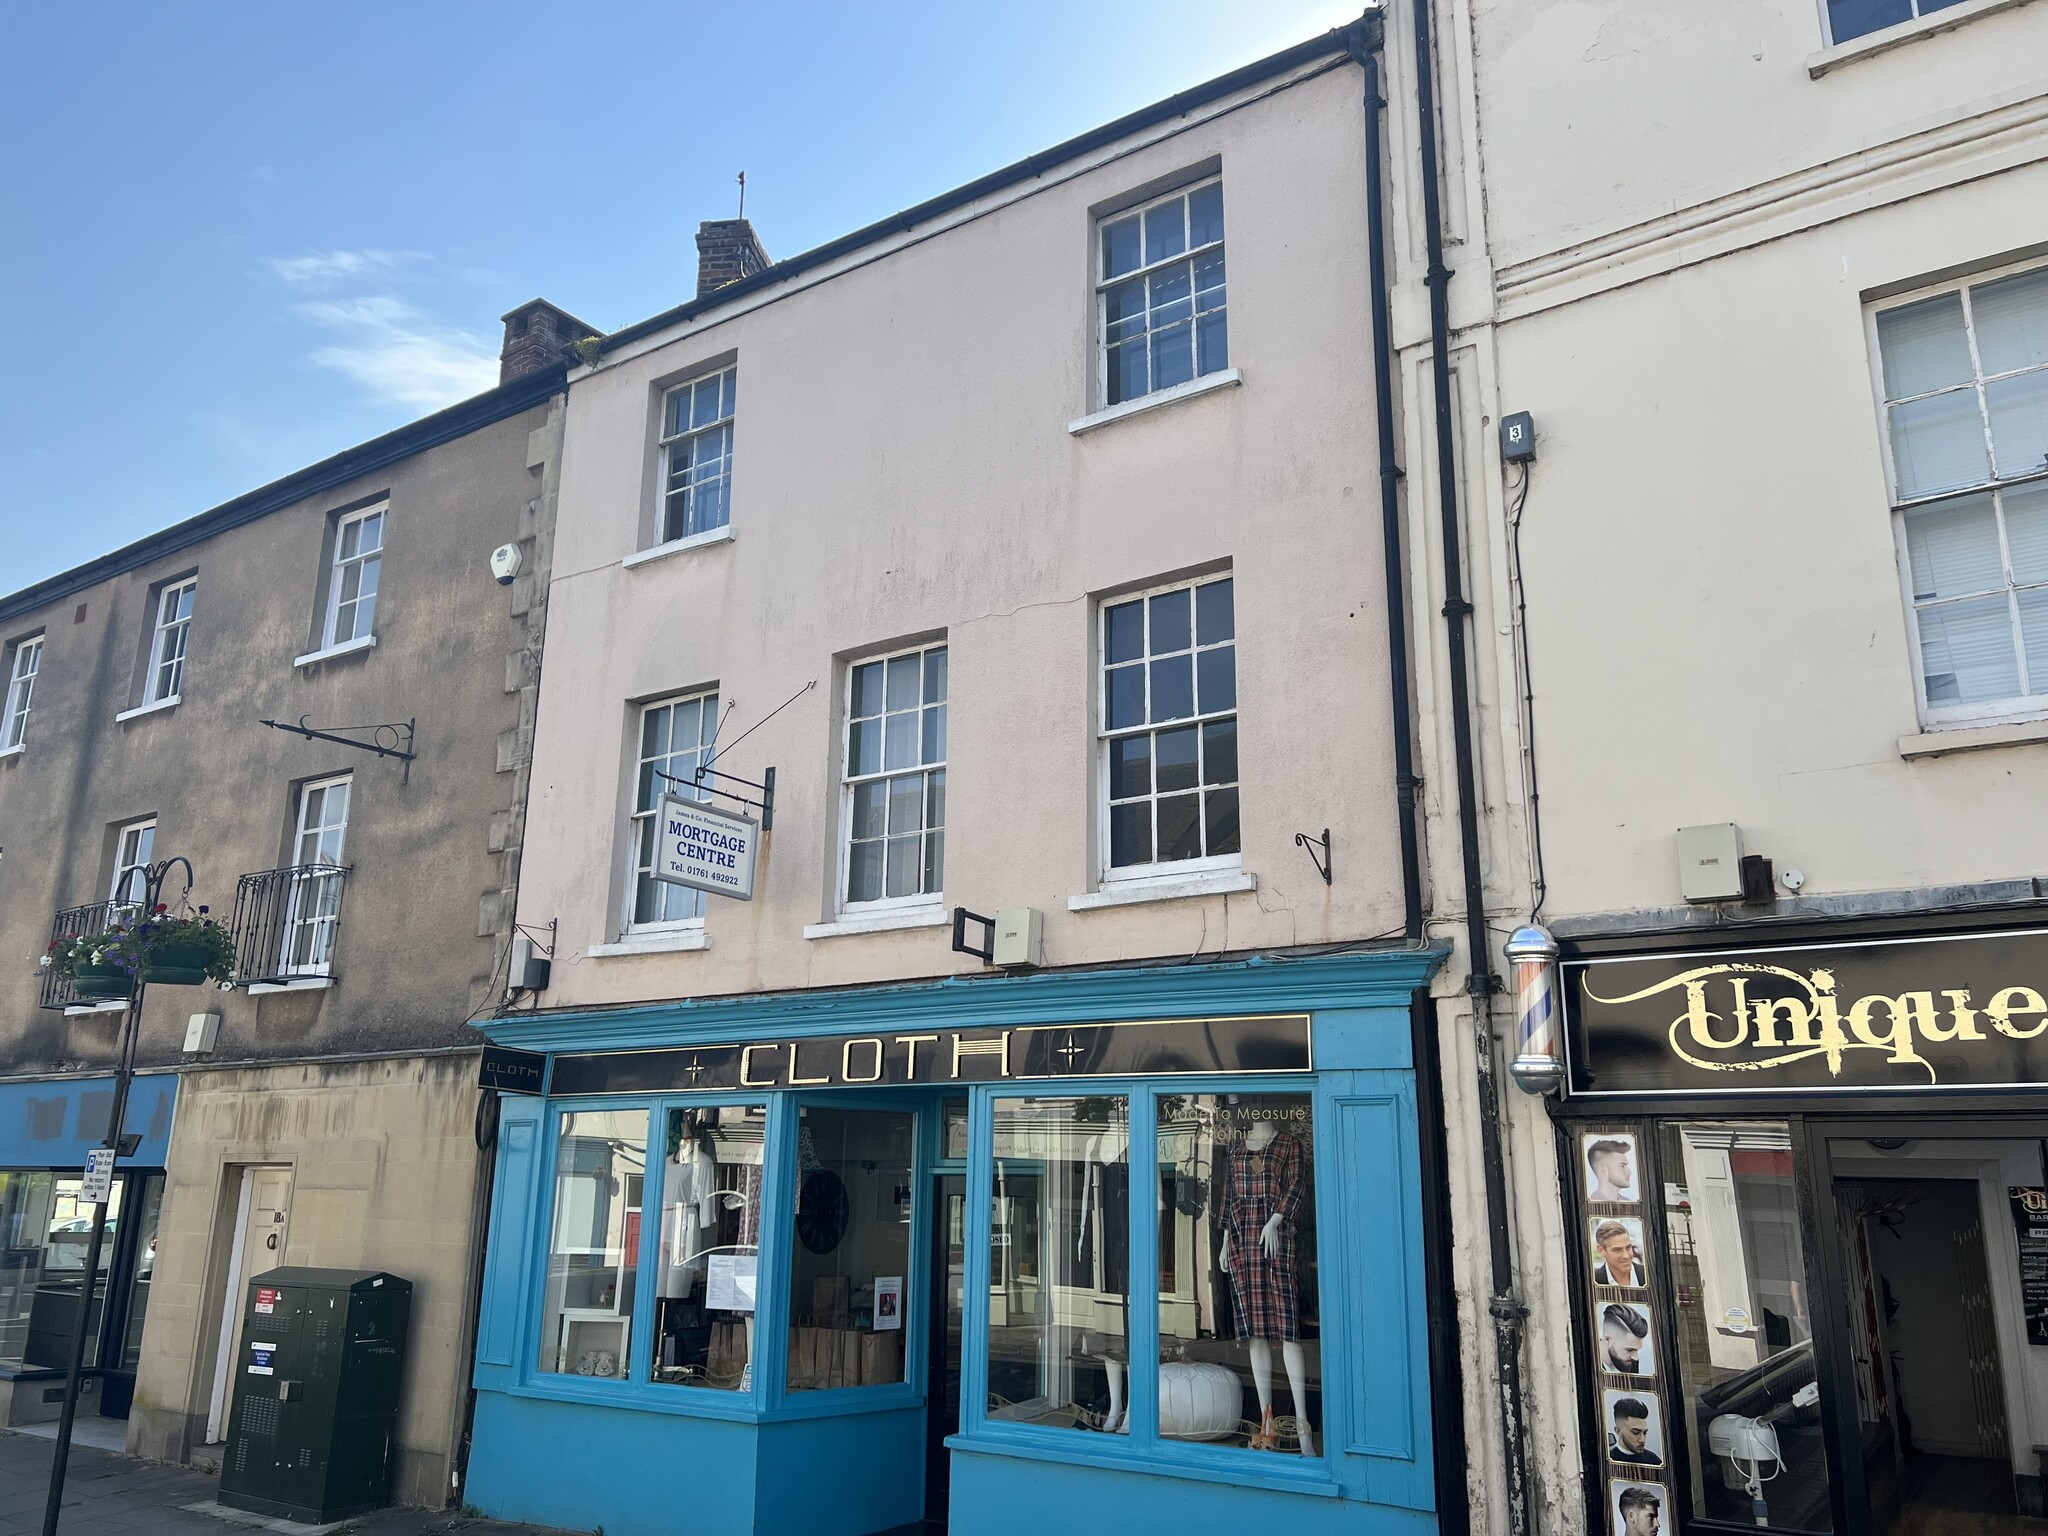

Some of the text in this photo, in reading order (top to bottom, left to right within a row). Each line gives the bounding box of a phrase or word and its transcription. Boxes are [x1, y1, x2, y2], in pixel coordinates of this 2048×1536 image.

[1512, 427, 1519, 438] 3
[675, 810, 690, 819] James
[703, 817, 724, 828] Financial
[724, 823, 743, 833] Services
[668, 820, 746, 854] MORTGAGE
[676, 841, 736, 869] CENTRE
[670, 860, 739, 886] Tel. 01761 492922
[1666, 963, 2048, 1083] Unique
[486, 1062, 539, 1078] CLOTH
[740, 1031, 1012, 1087] CLOTH
[1164, 1107, 1306, 1121] Made To Measure
